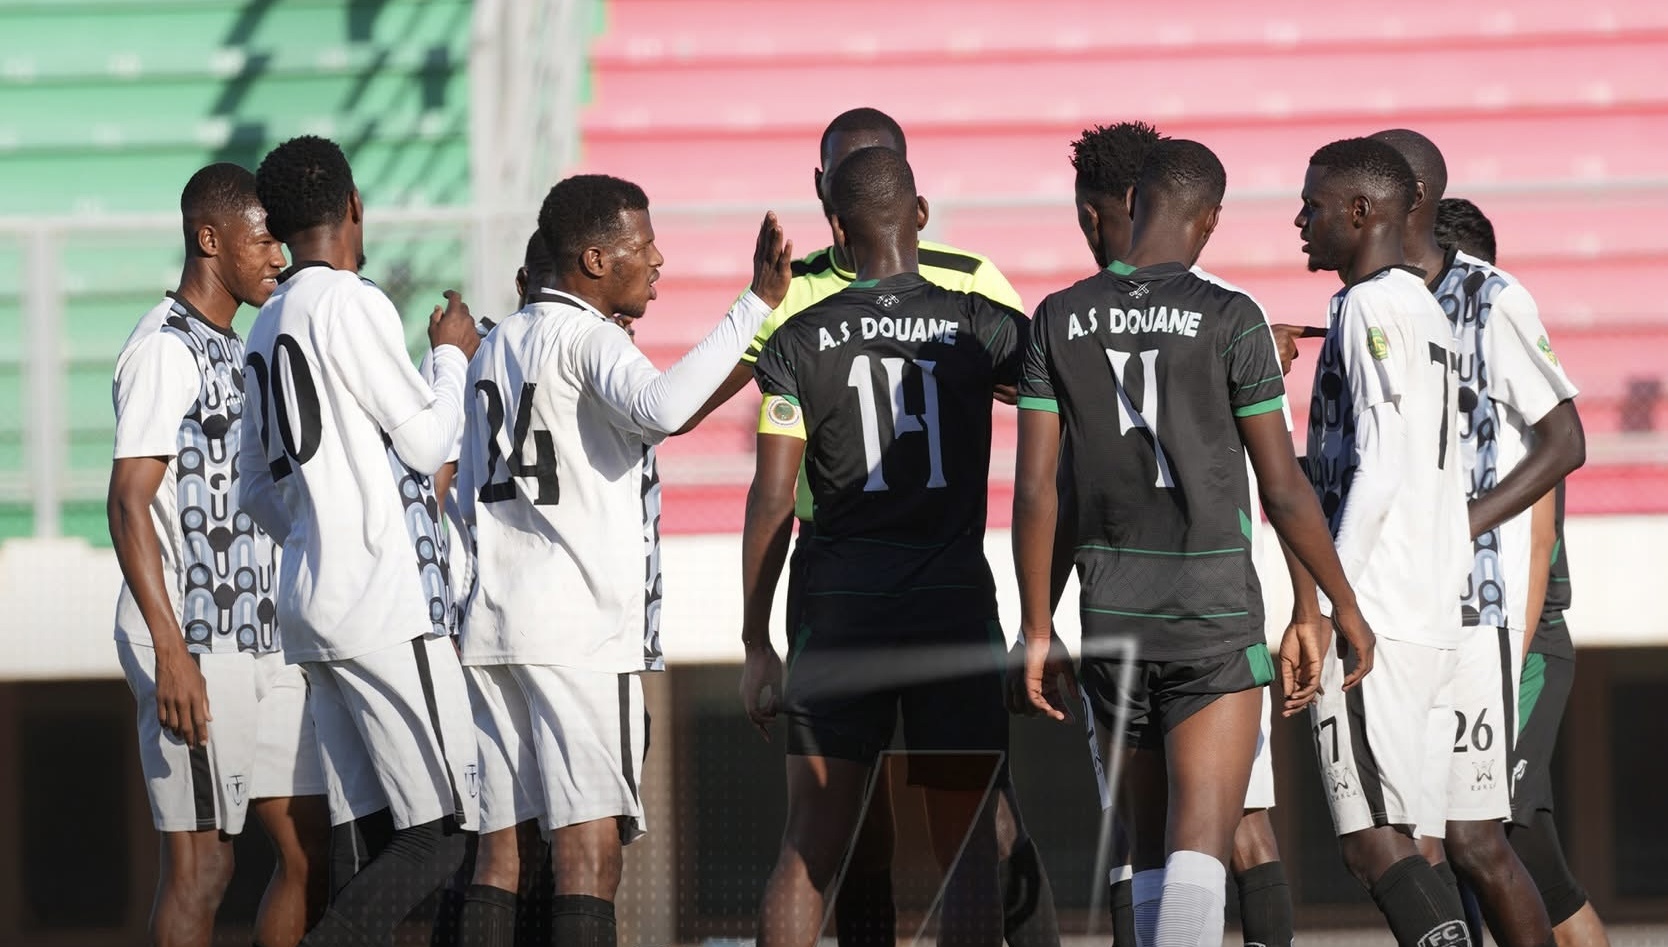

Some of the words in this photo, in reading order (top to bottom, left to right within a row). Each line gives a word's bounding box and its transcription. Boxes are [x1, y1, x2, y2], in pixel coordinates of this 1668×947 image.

[819, 320, 850, 351] A.S
[861, 317, 959, 346] DOUANE
[1068, 307, 1098, 340] A.S
[1109, 306, 1203, 338] DOUANE
[848, 355, 948, 492] 14
[1105, 349, 1175, 488] 4
[475, 379, 560, 505] 24
[1453, 708, 1493, 753] 26
[1428, 925, 1459, 947] FC
